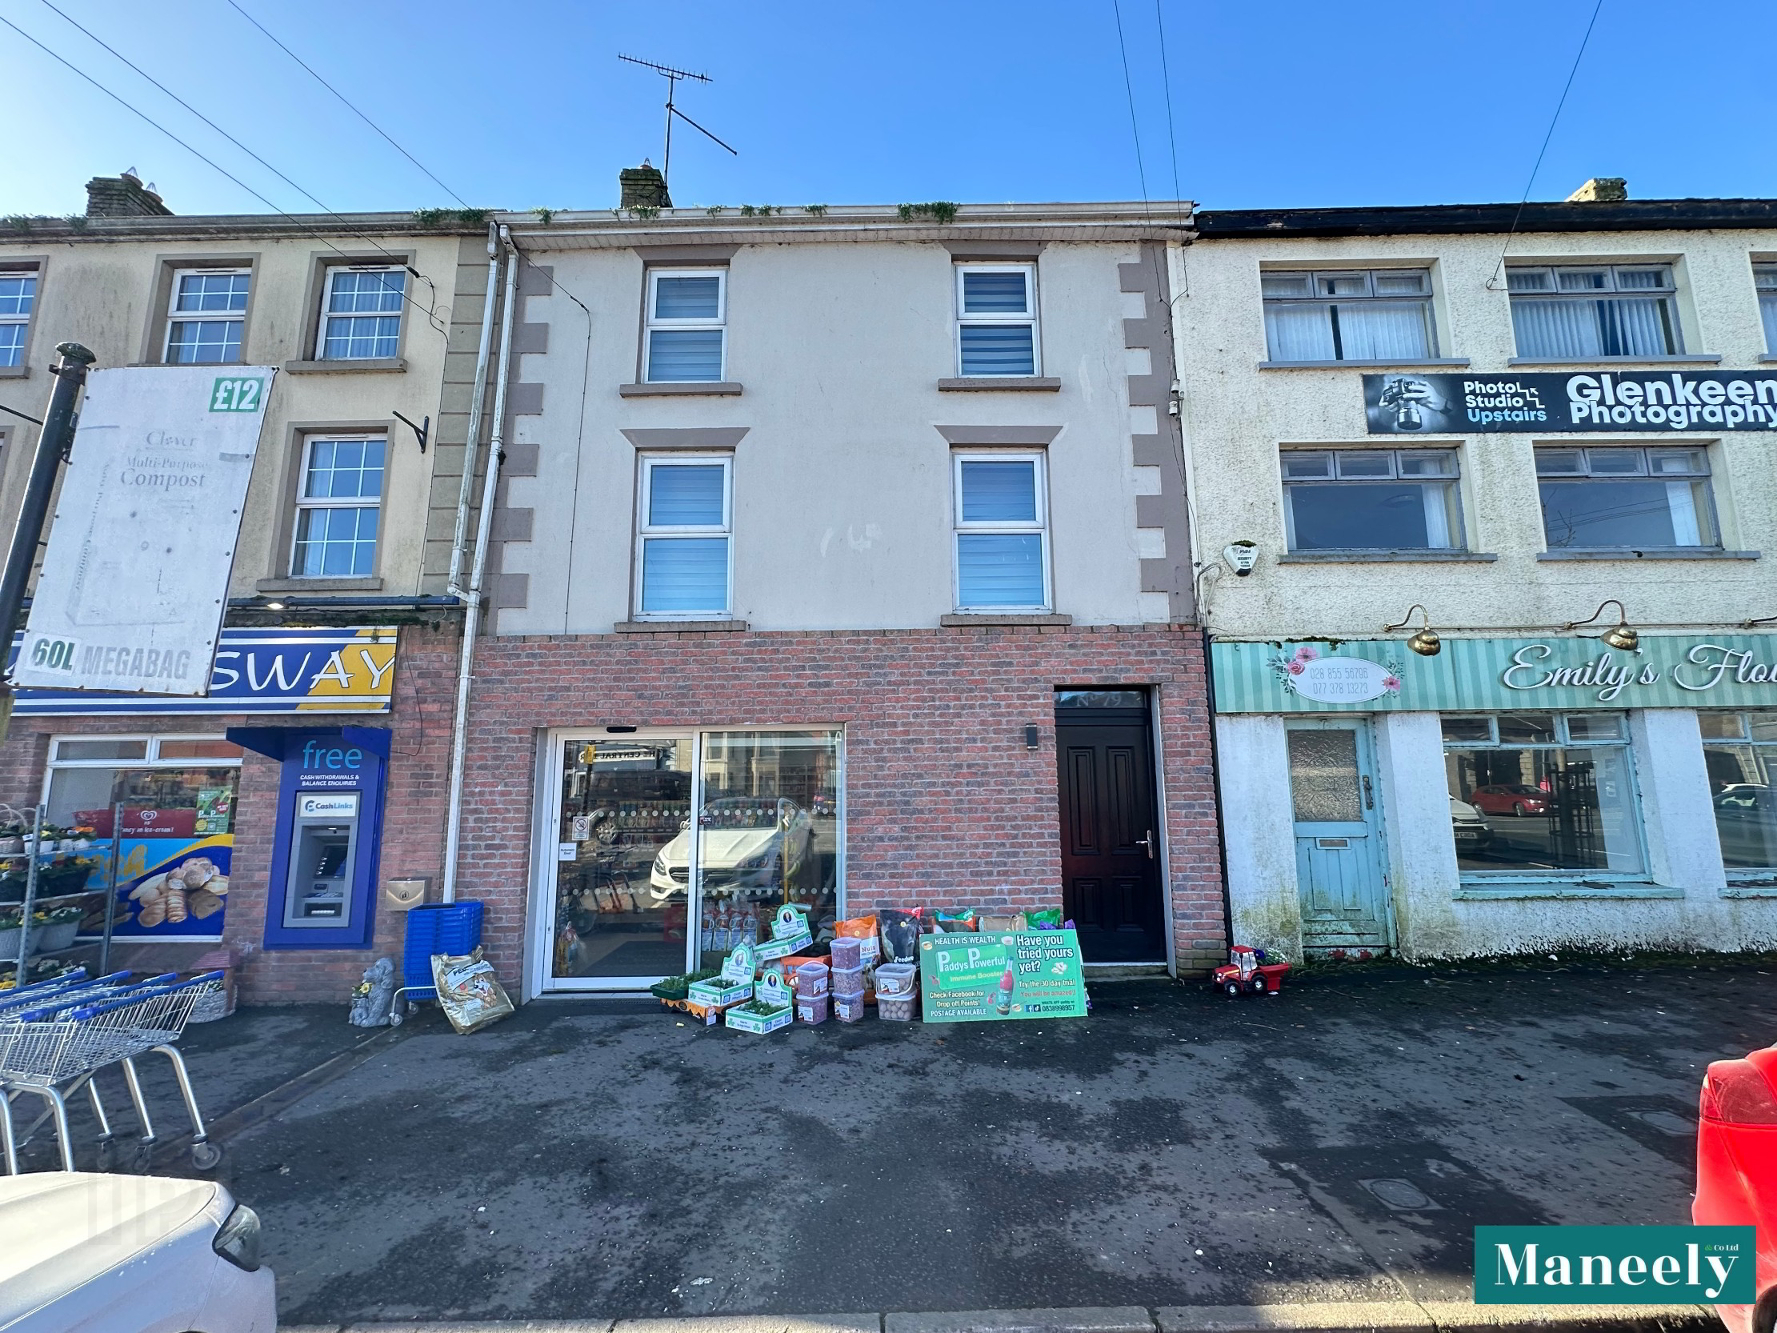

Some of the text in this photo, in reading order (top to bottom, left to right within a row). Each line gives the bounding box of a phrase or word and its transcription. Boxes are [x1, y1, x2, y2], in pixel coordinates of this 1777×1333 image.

[1463, 380, 1517, 394] Photo
[1566, 374, 1777, 406] Glenkeen
[212, 379, 260, 411] £12
[1465, 393, 1524, 408] Studio
[1466, 406, 1547, 425] Upstairs
[1569, 398, 1777, 429] Photography
[120, 467, 206, 492] Compost
[31, 638, 191, 681] 60L MEGABAG
[1310, 668, 1325, 679] 028
[1327, 668, 1341, 679] 855
[1503, 644, 1661, 701] Emily's
[1312, 682, 1369, 695] 077 378 13273
[1103, 694, 1122, 707] 79
[302, 739, 363, 769] free
[934, 935, 996, 945] HEALTH IS WEALTH
[1016, 935, 1064, 948] Have you
[937, 947, 1006, 973] Paddys Powerful
[1017, 947, 1074, 961] tried yours
[1018, 960, 1041, 975] yet?
[950, 974, 977, 983] Immune
[1018, 980, 1029, 989] Try
[1050, 979, 1061, 987] day
[929, 990, 947, 999] Check
[948, 990, 975, 998] Facebook
[930, 1008, 987, 1017] POSTAGE AVAILABLE
